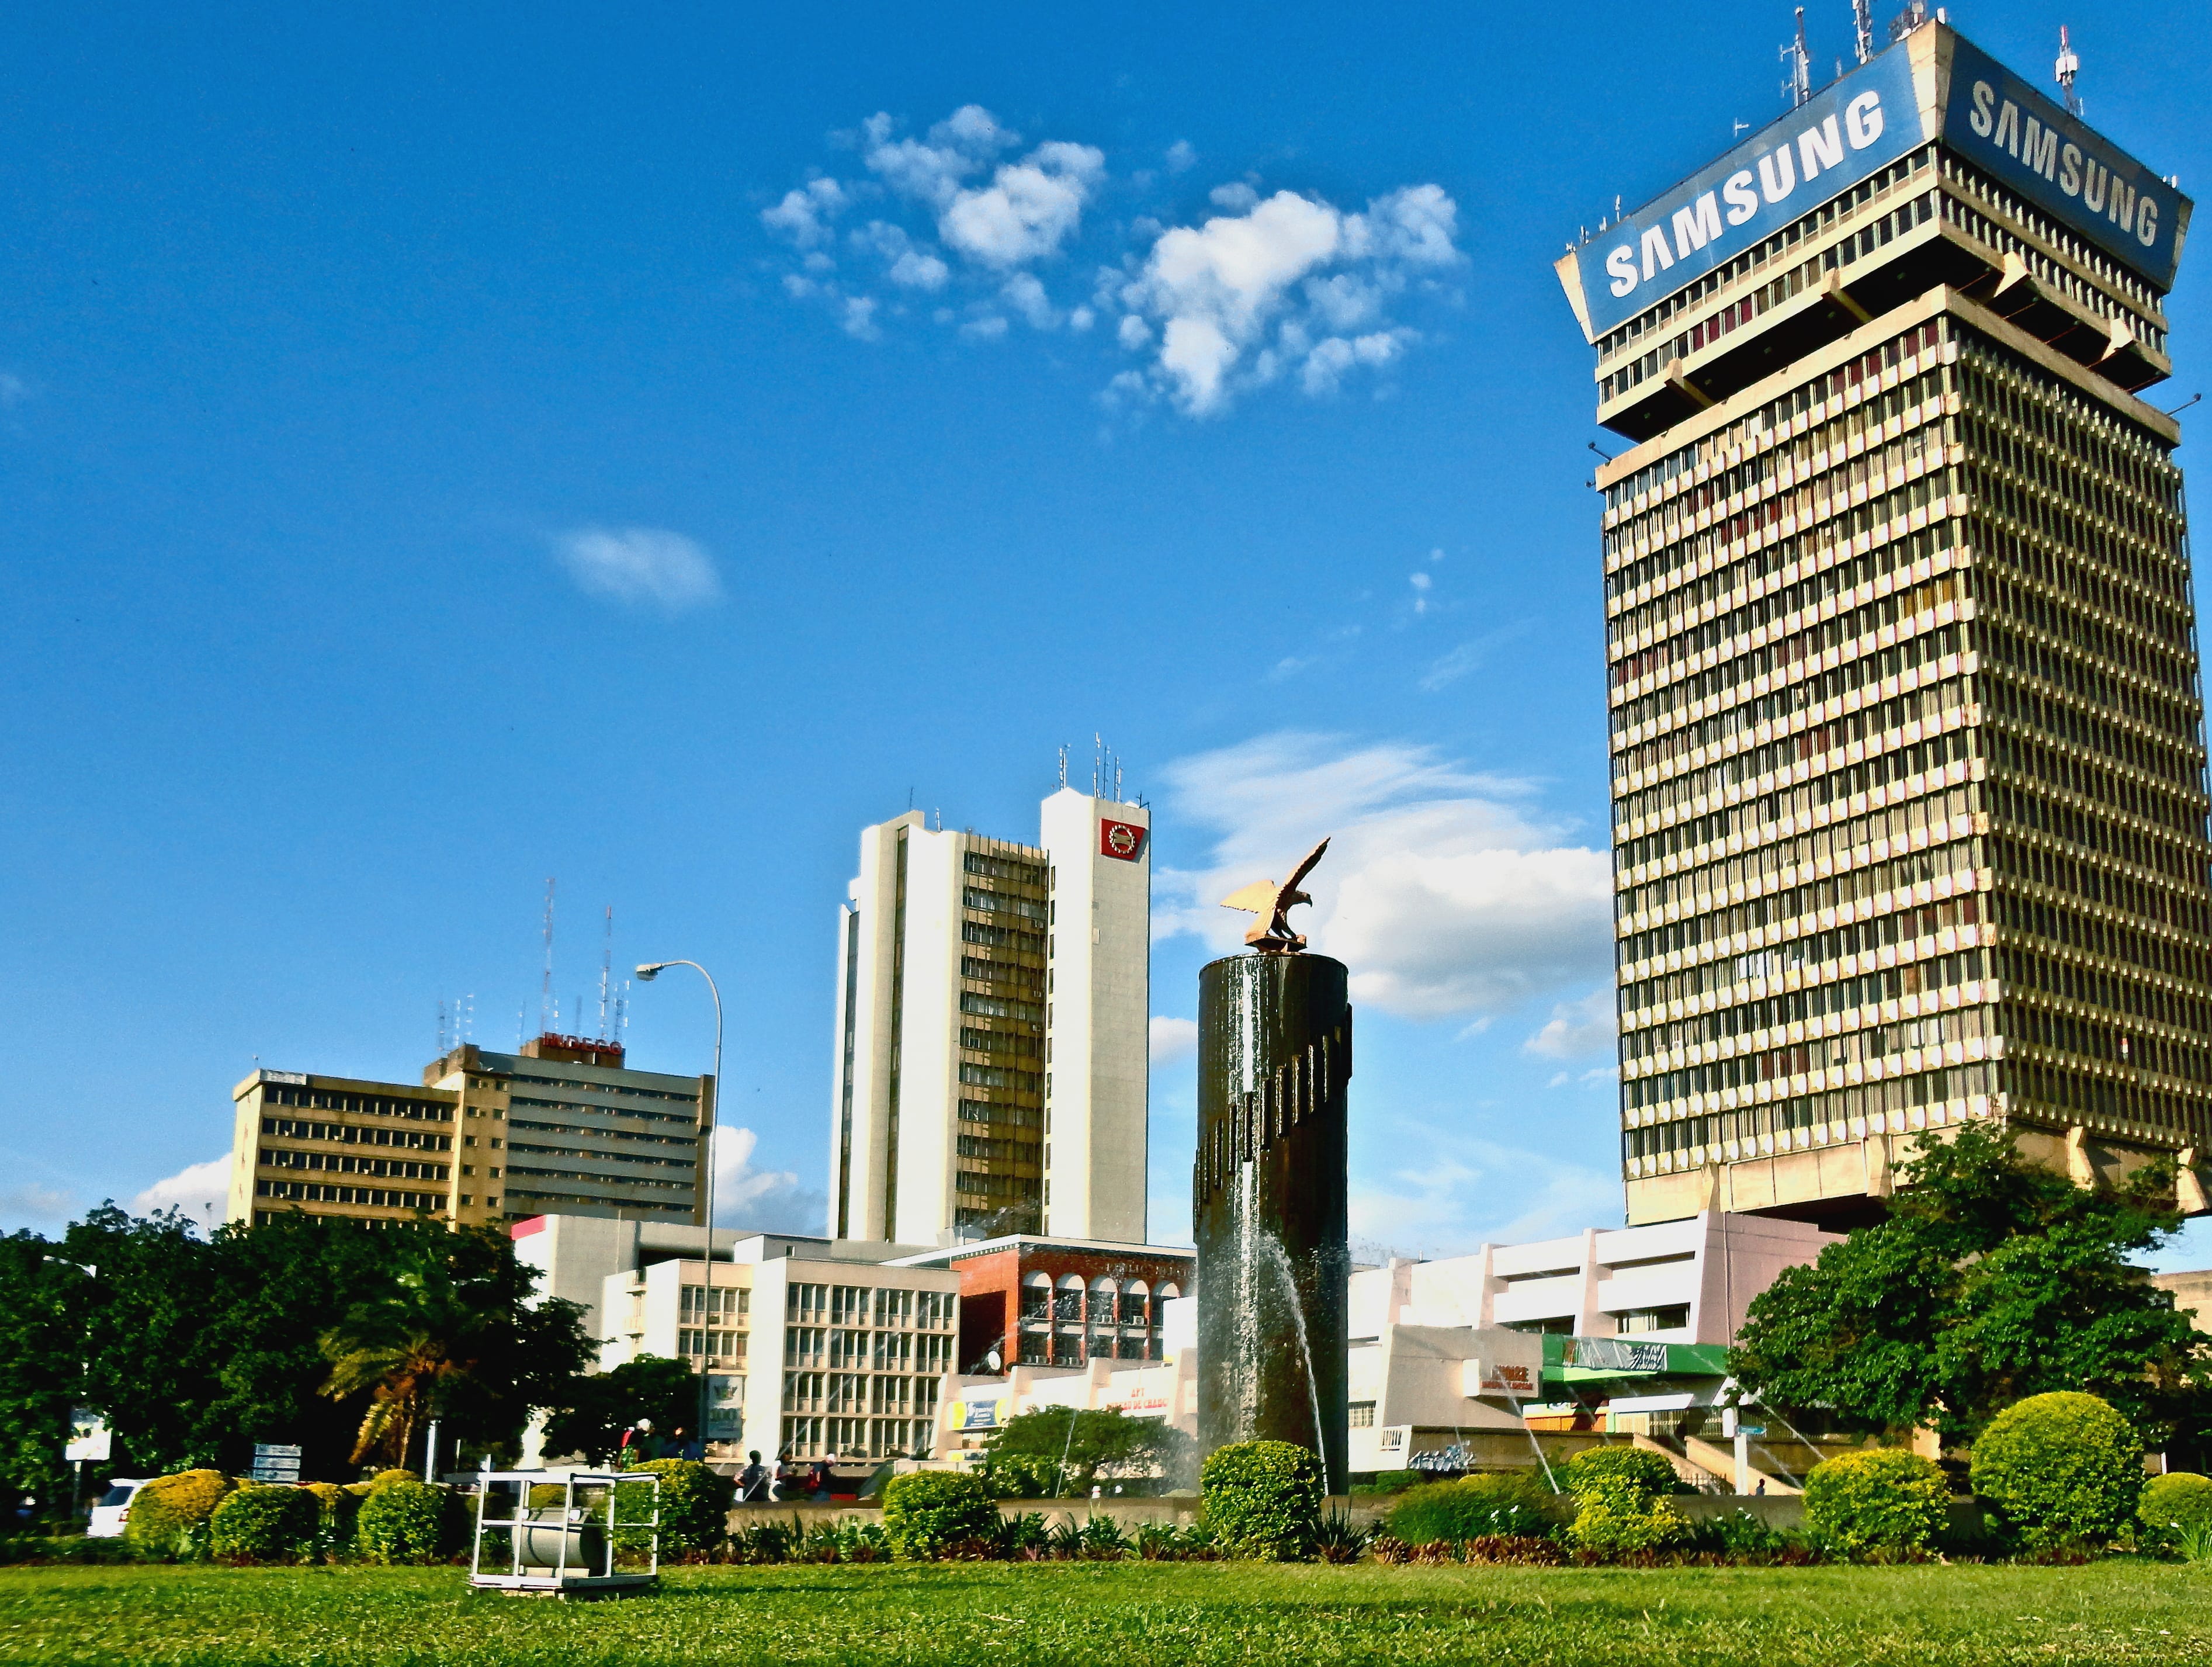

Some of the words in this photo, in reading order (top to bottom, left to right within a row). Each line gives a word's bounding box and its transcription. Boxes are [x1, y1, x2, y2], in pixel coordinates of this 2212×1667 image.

[1606, 90, 1884, 298] SAMSUNG
[1970, 81, 2158, 247] SAMSUNG
[544, 1032, 623, 1055] INDECO
